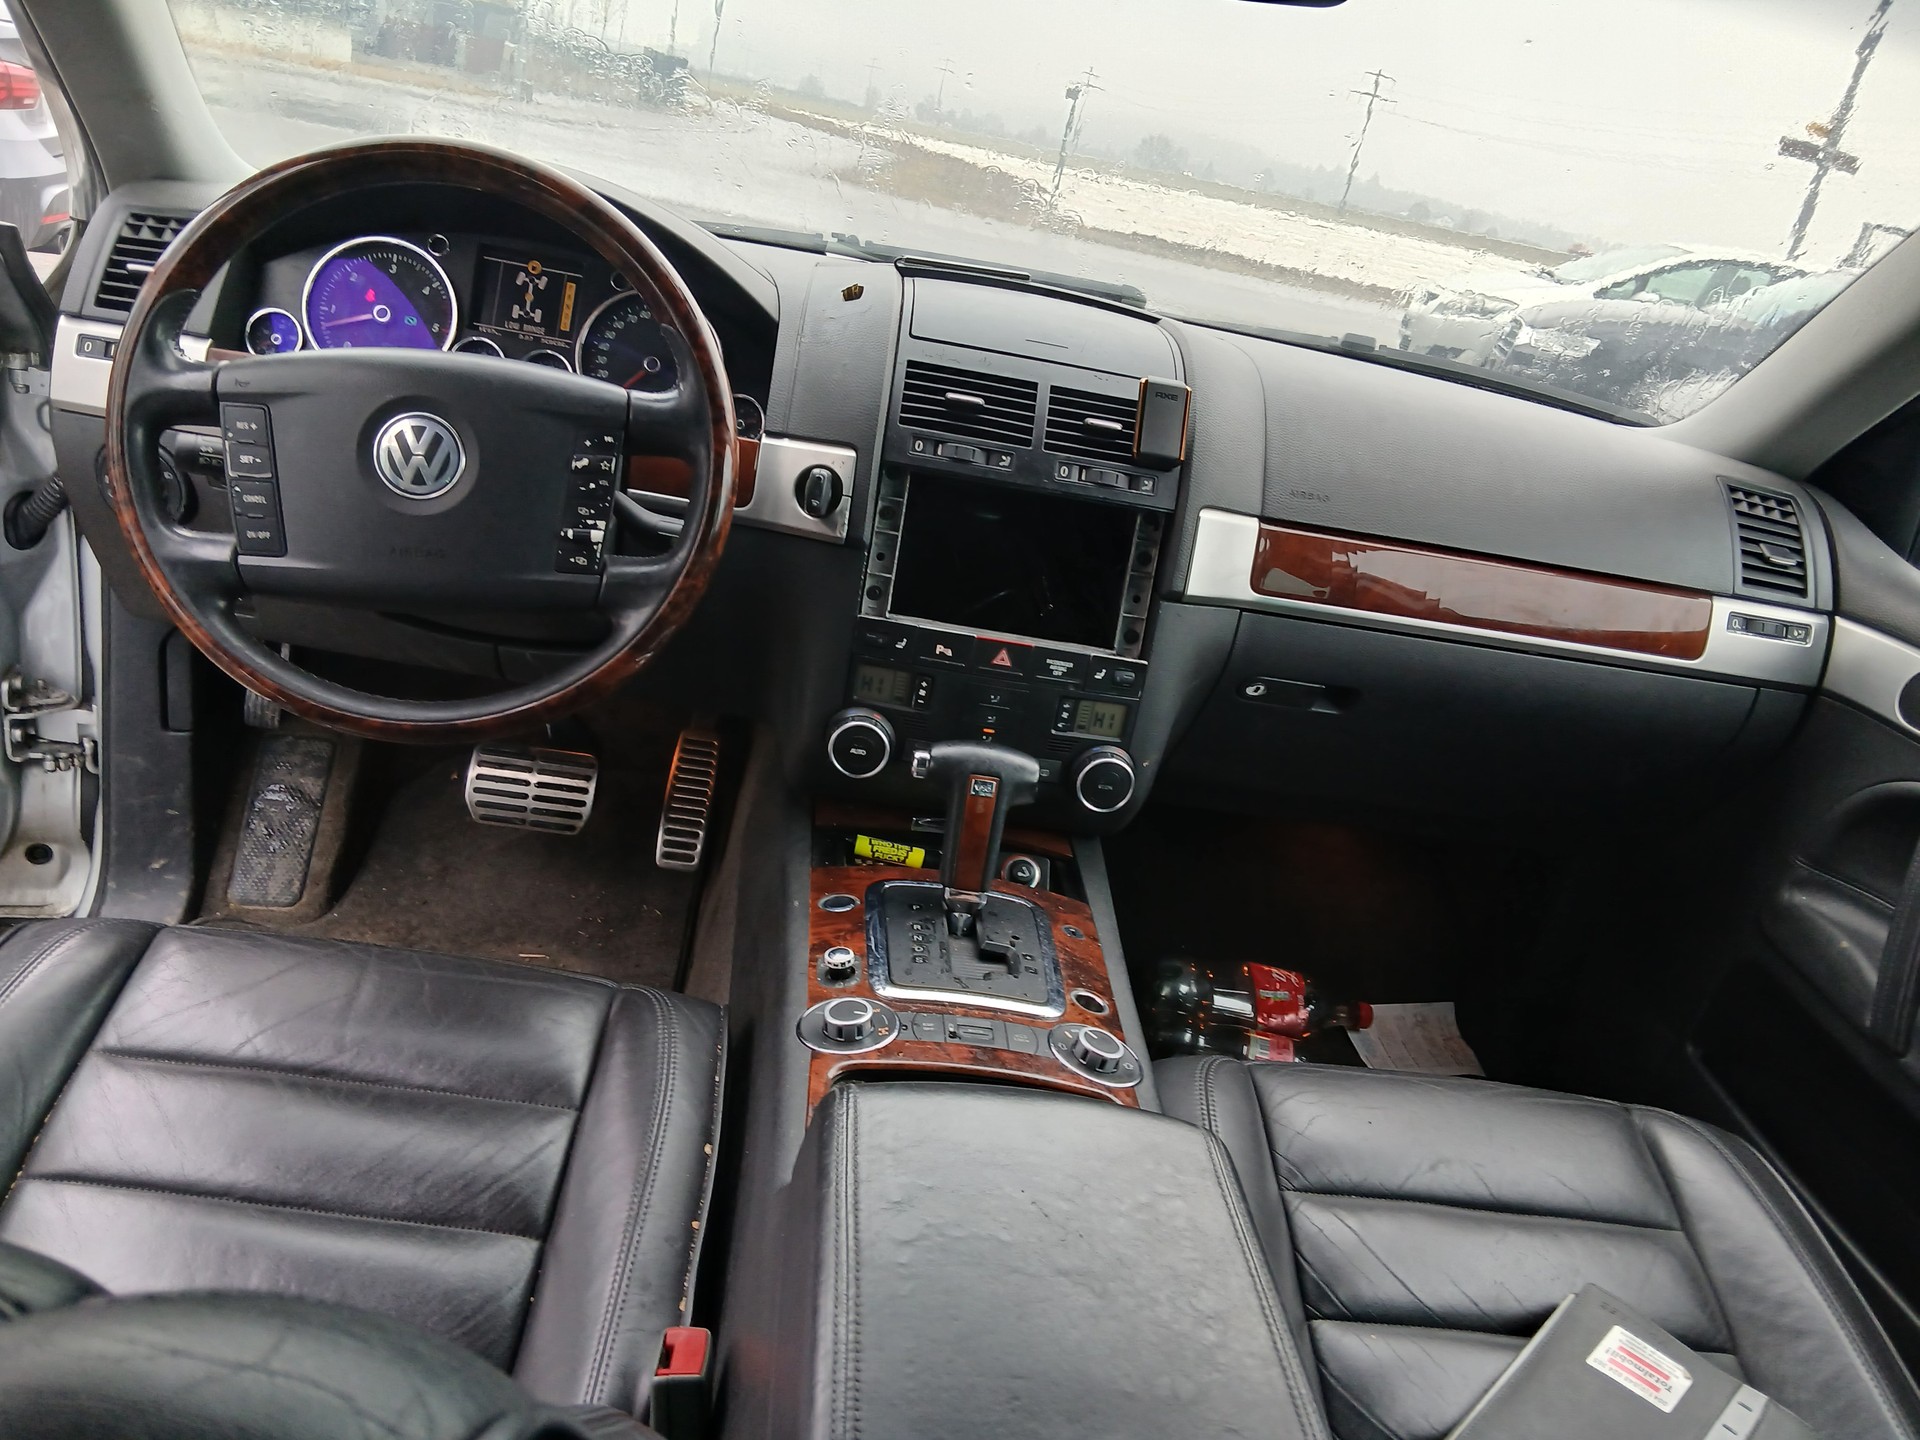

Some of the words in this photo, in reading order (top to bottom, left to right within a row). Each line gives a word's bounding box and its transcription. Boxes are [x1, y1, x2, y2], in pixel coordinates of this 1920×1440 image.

[388, 264, 398, 274] 3
[431, 322, 440, 333] 5
[84, 341, 92, 352] 0
[1155, 391, 1179, 402] AXE
[914, 440, 924, 452] 0
[239, 454, 254, 465] SET
[1059, 466, 1069, 477] 0
[242, 493, 268, 505] CANCEL
[1604, 1346, 1674, 1394] Totalmobil!
